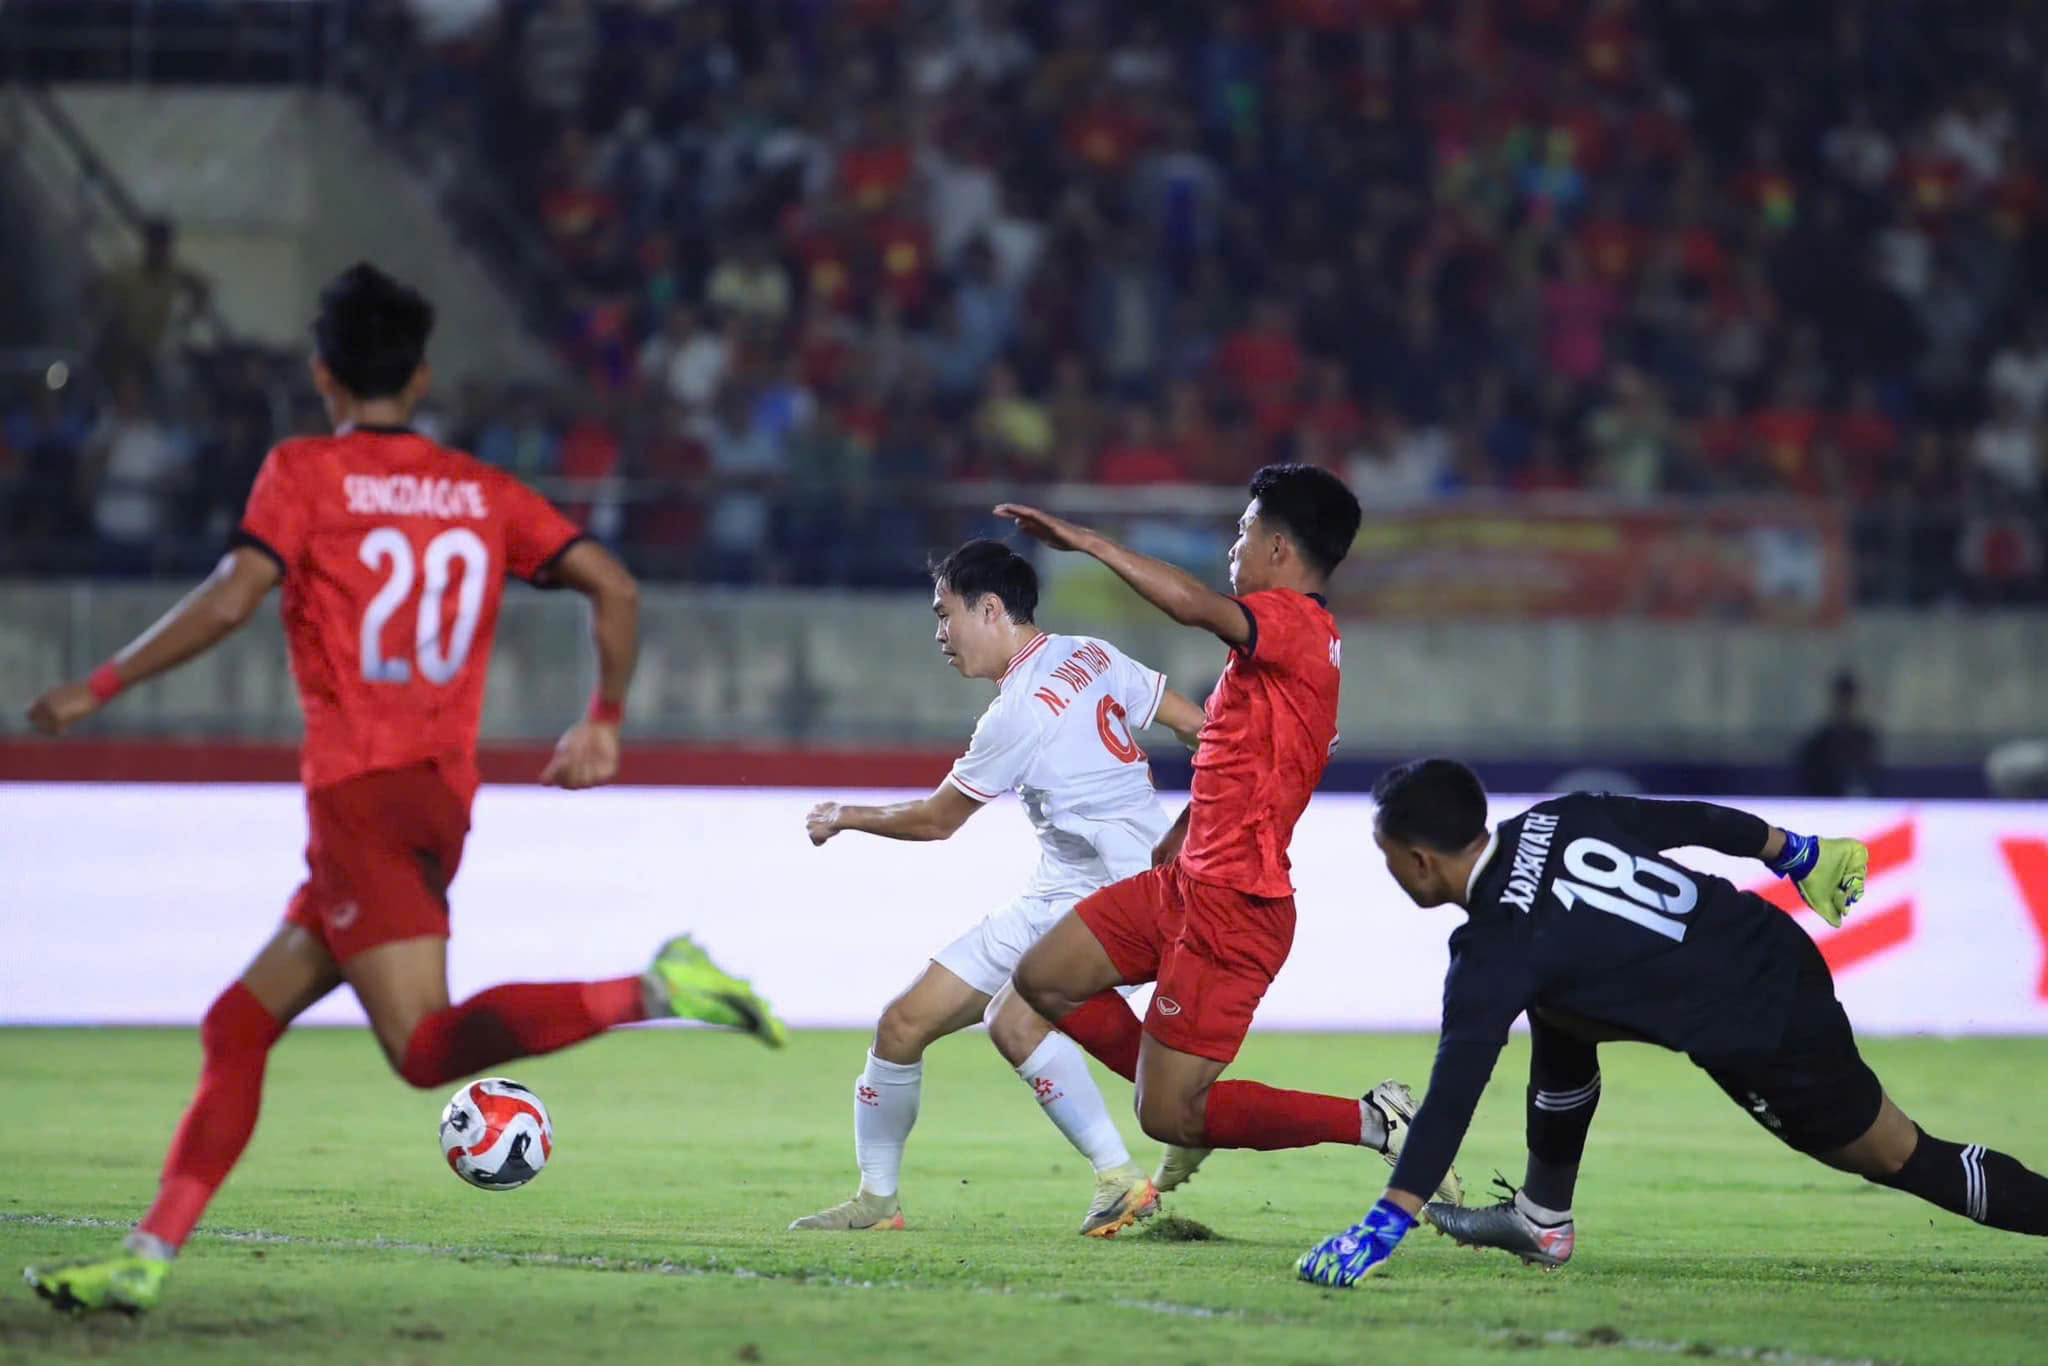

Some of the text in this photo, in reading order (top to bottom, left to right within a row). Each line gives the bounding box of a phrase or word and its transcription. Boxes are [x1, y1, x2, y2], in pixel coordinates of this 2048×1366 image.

[359, 526, 490, 686] 20
[1034, 686, 1071, 717] N.
[1500, 812, 1560, 914] XAYSAVATH
[1551, 837, 1698, 943] 18
